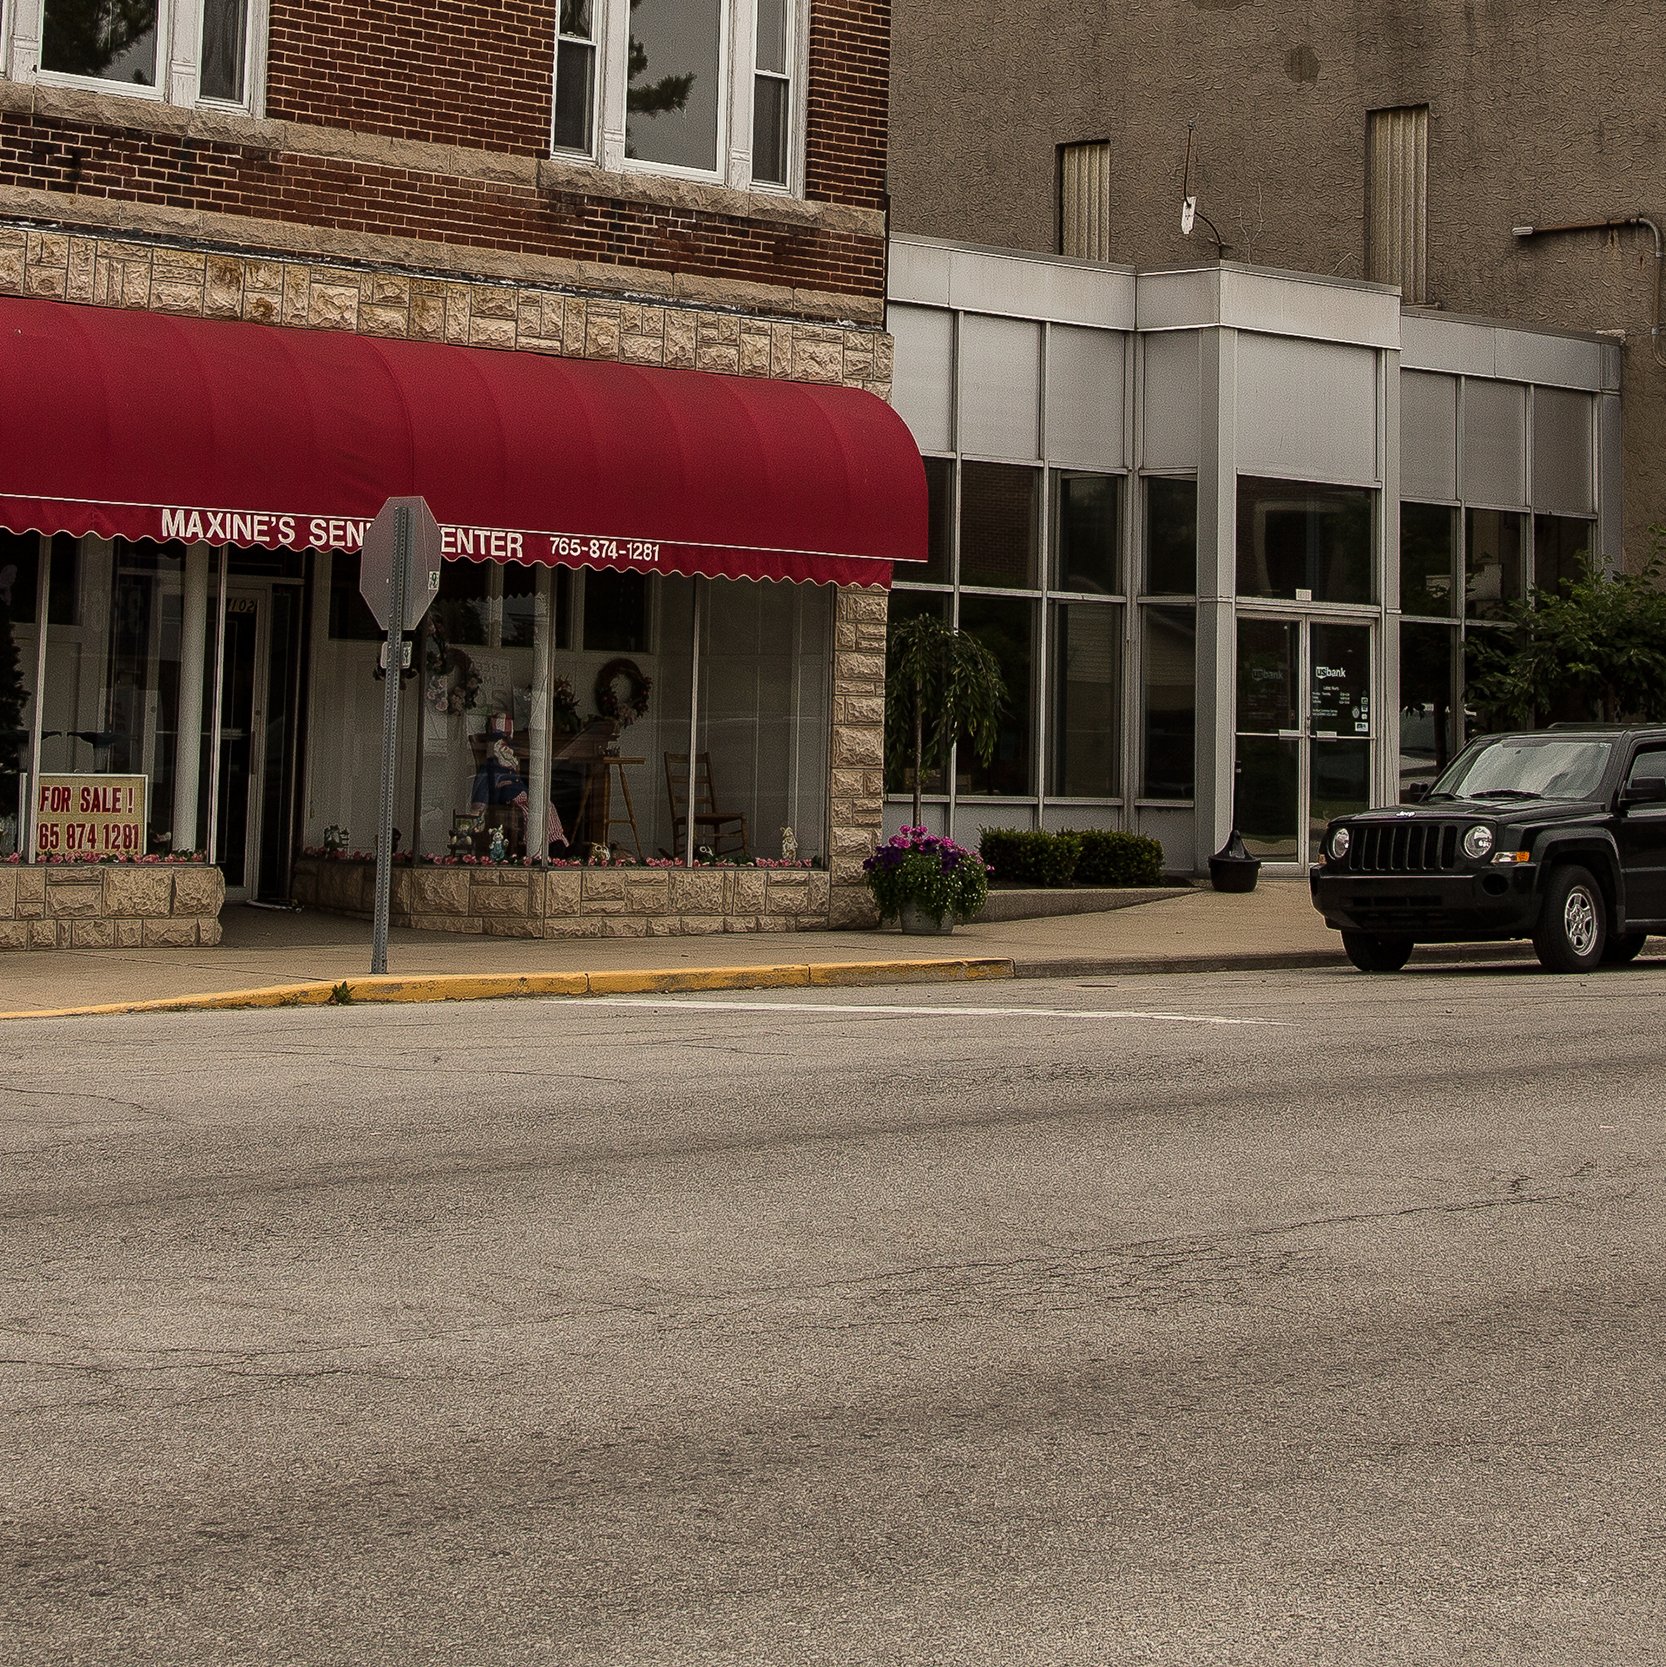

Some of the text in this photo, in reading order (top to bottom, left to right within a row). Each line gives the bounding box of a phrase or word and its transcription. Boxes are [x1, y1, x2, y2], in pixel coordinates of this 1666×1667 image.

[161, 508, 660, 562] MAXINE'S SEN ENTER 765-874-1281
[231, 598, 255, 612] 102
[39, 786, 72, 813] FOR
[36, 823, 139, 850] 65 874 1281
